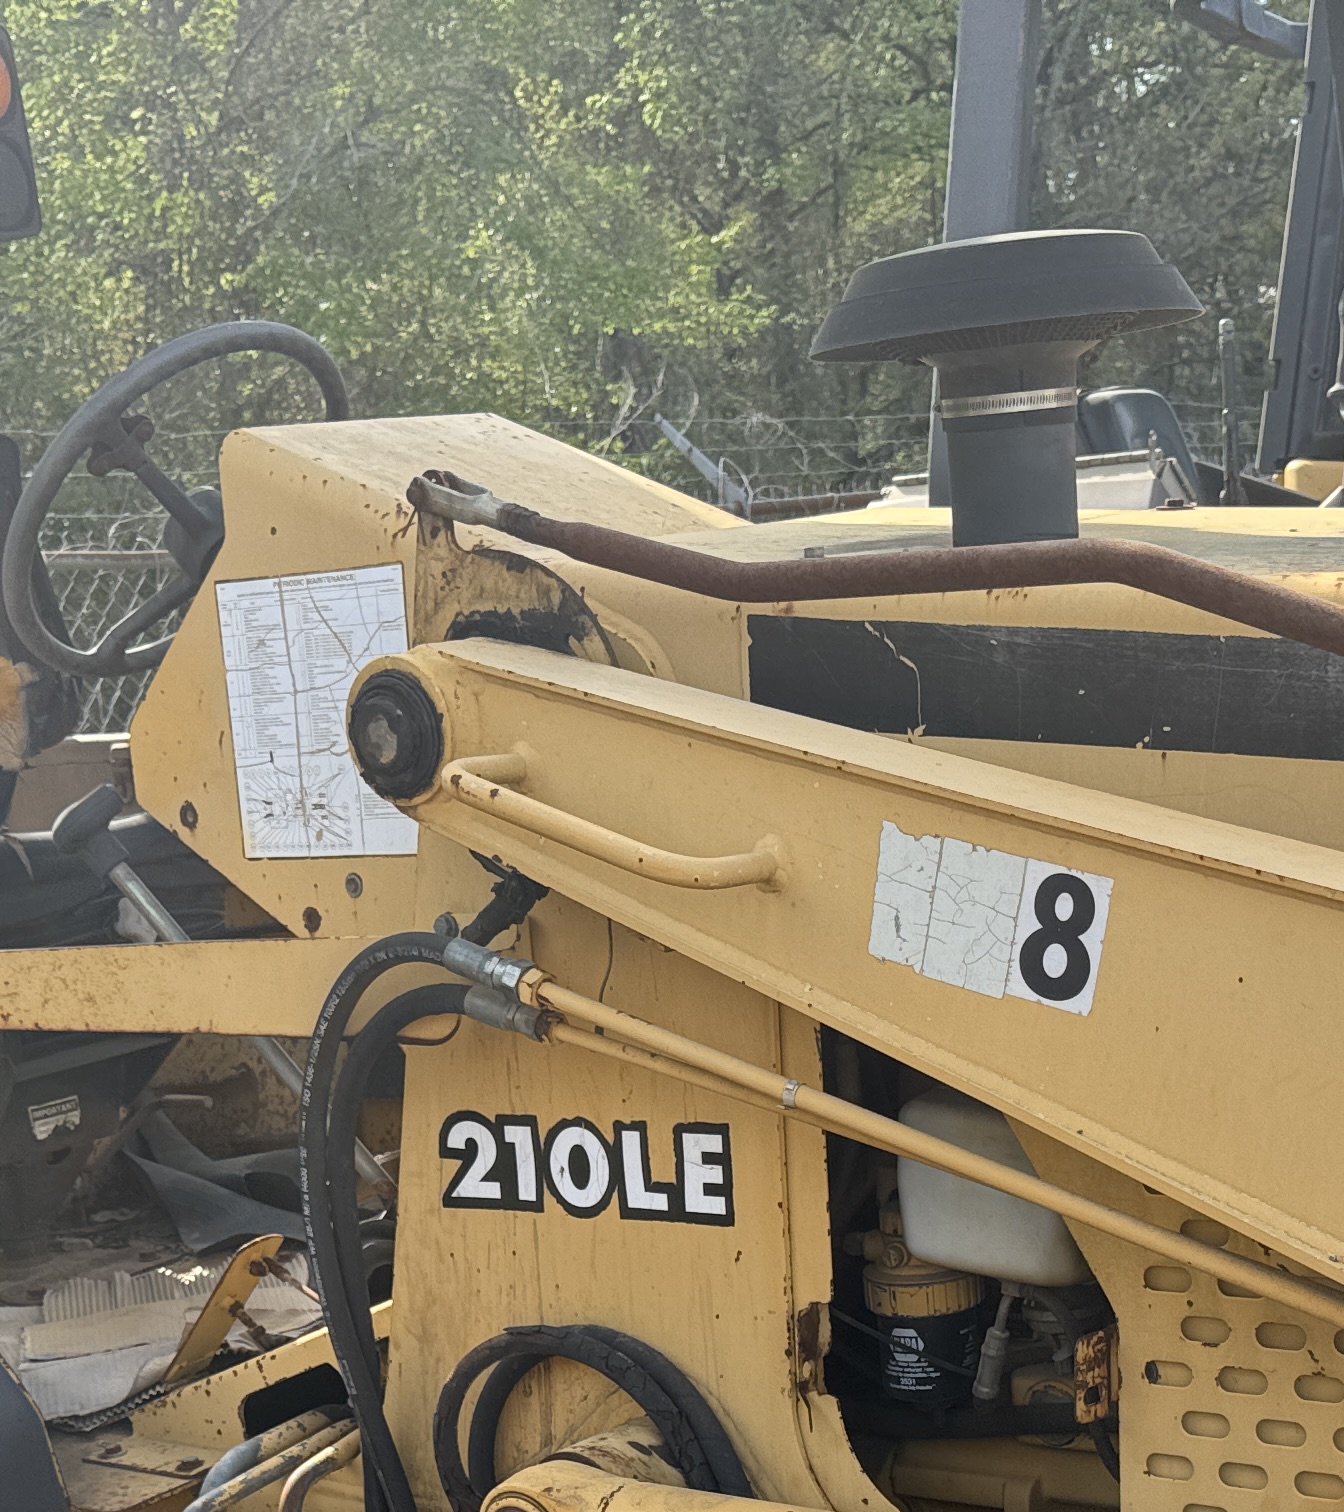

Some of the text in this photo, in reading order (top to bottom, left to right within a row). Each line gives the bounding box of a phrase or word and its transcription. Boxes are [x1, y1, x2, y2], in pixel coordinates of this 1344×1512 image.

[272, 573, 355, 589] PRIODIC MAINTENANCE
[1019, 872, 1096, 1002] 8
[444, 1118, 728, 1218] 210LE
